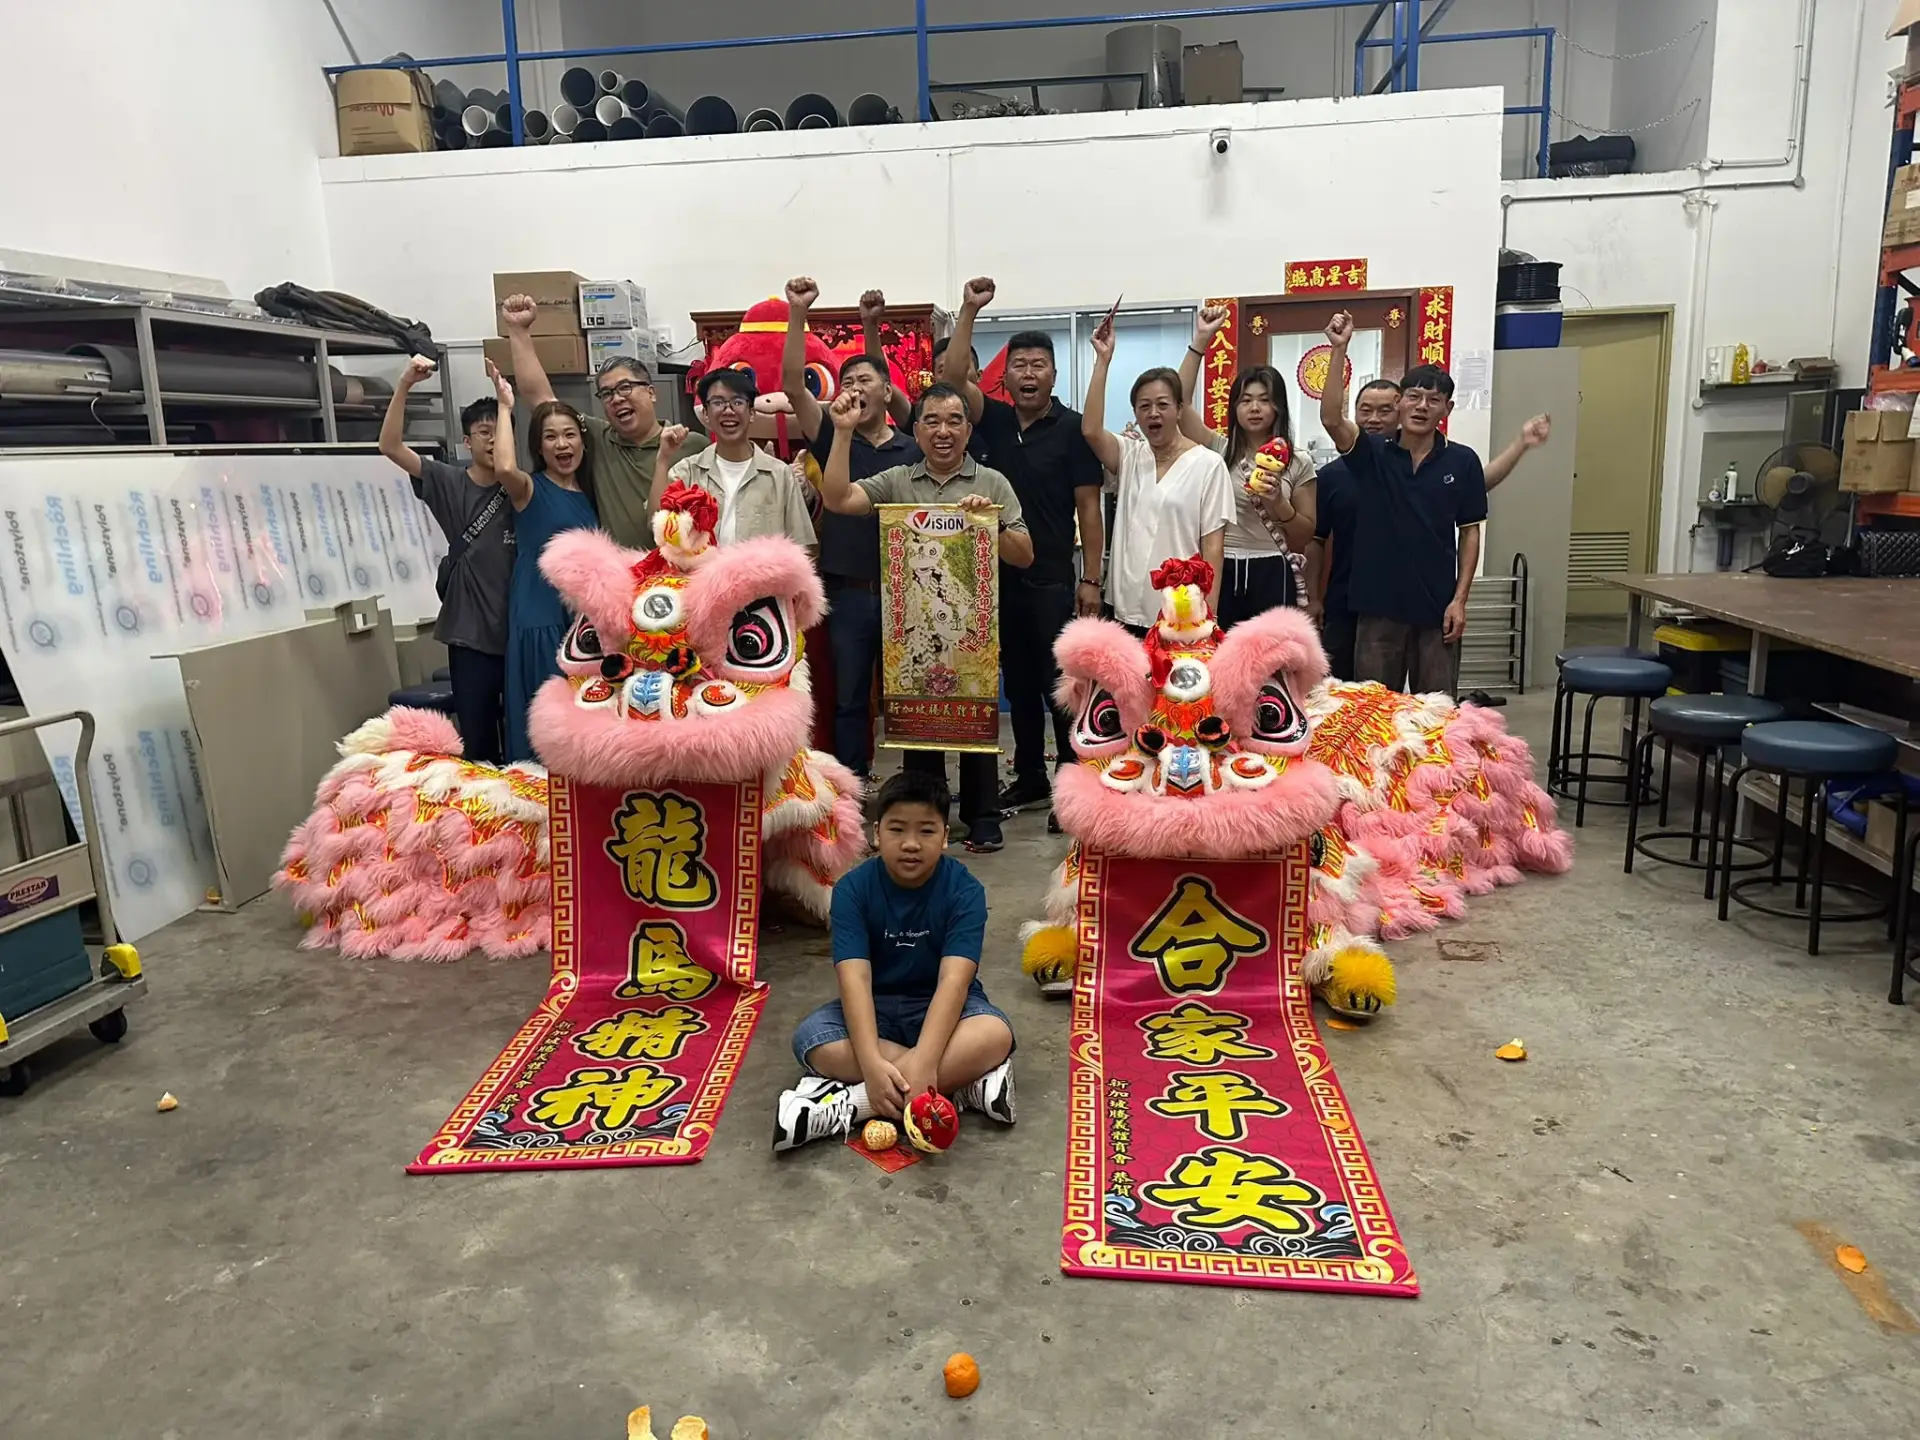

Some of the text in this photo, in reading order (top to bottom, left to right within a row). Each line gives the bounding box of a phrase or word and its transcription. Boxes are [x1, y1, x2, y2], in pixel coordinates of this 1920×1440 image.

[10, 881, 47, 900] PRESTAR
[527, 790, 720, 1131] 龍馬精神
[1128, 873, 1326, 1236] 合家平安
